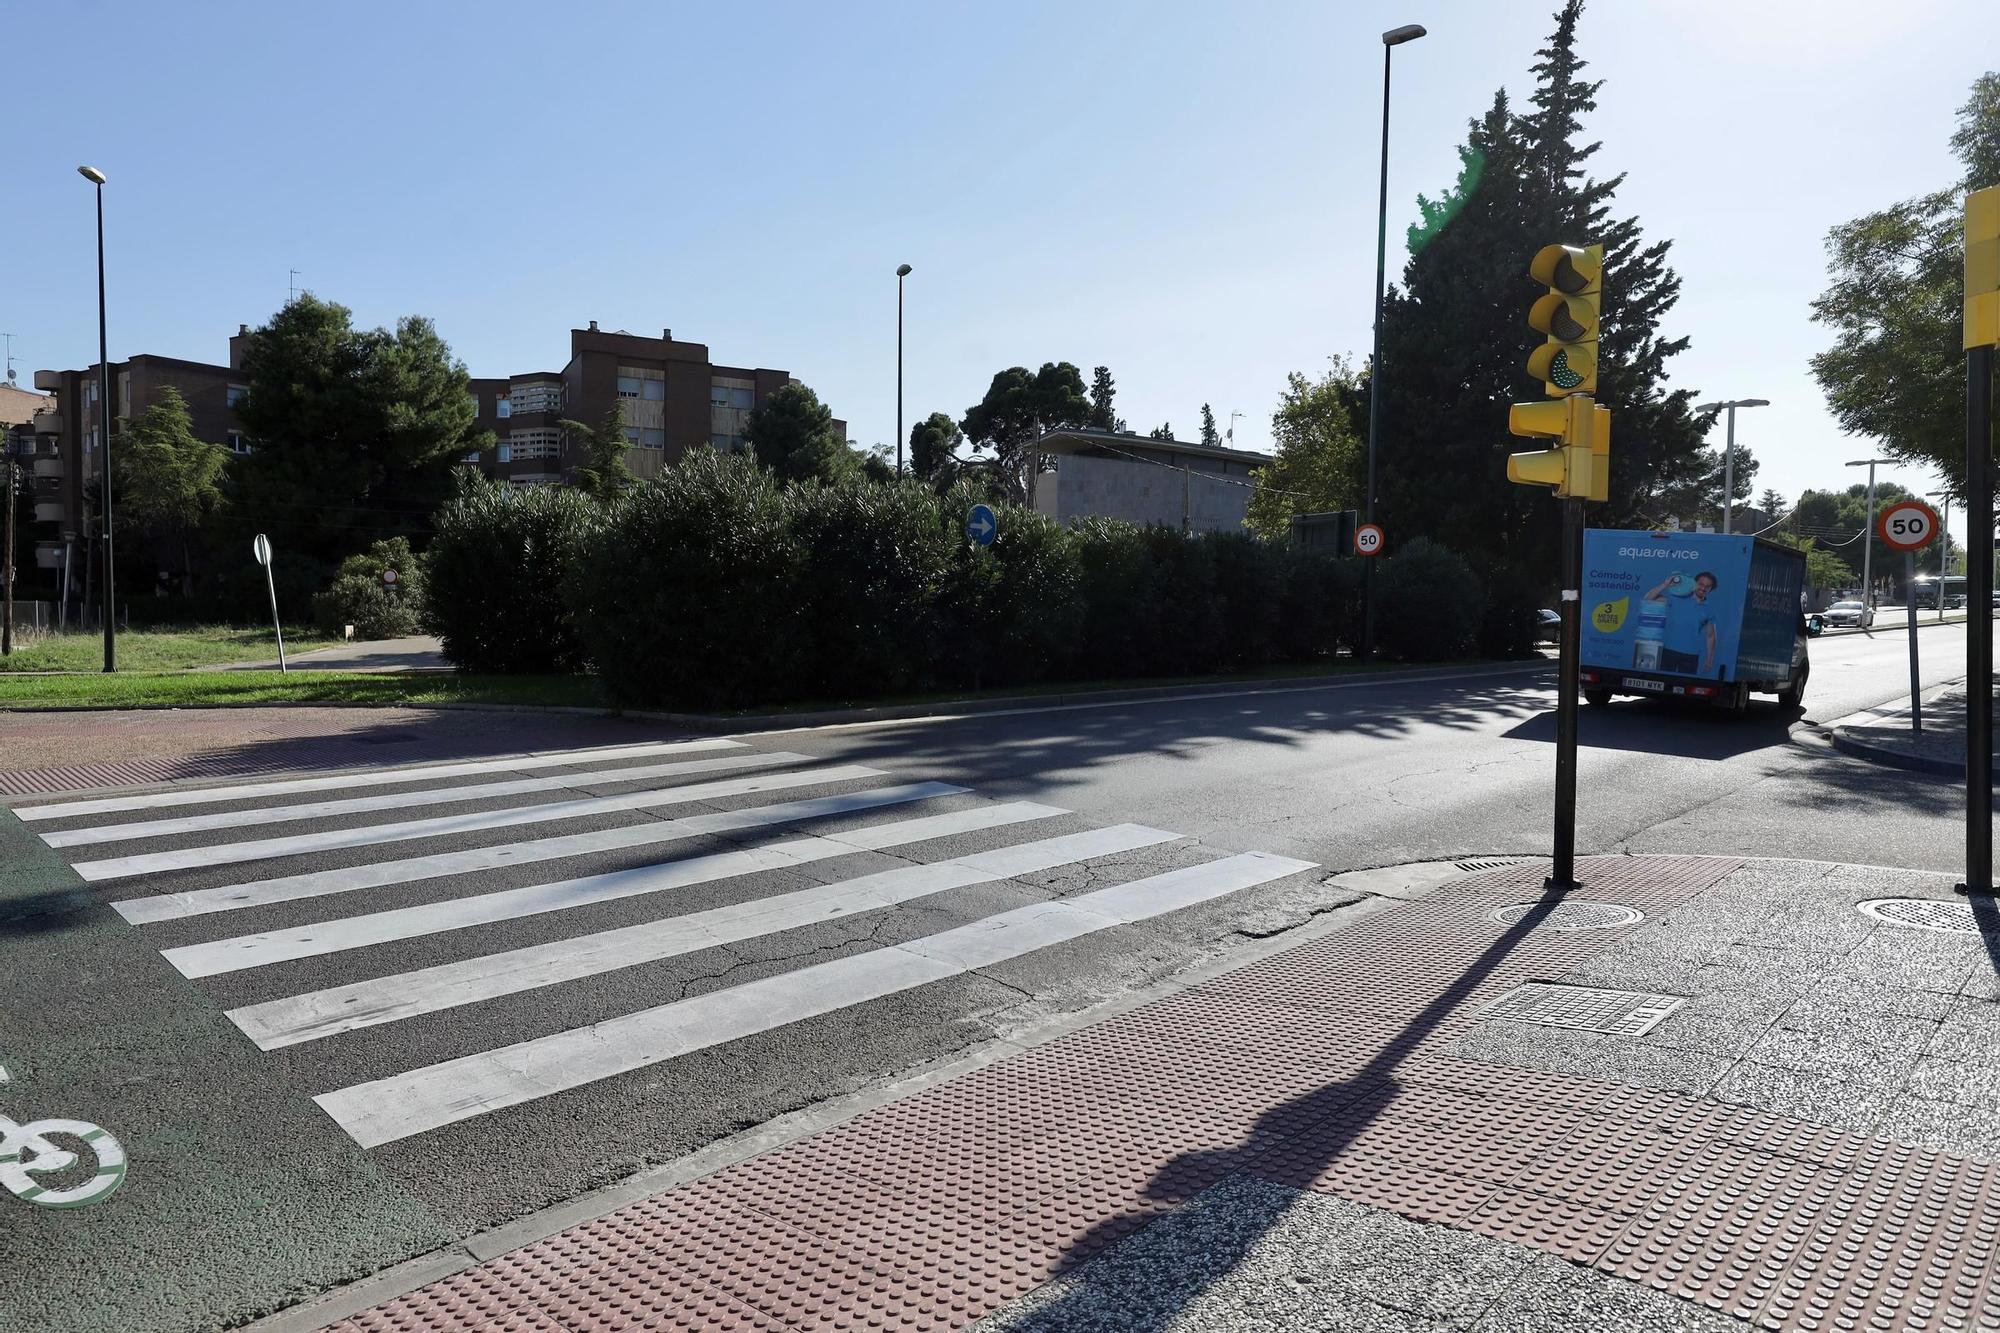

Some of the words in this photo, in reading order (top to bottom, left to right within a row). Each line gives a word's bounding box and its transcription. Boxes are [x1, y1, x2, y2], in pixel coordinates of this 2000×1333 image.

[1892, 518, 1924, 535] 50
[1360, 535, 1377, 546] 50
[1618, 547, 1699, 560] aquaservice
[1635, 574, 1642, 582] y
[1588, 581, 1641, 592] sostenible
[1604, 603, 1613, 614] 3
